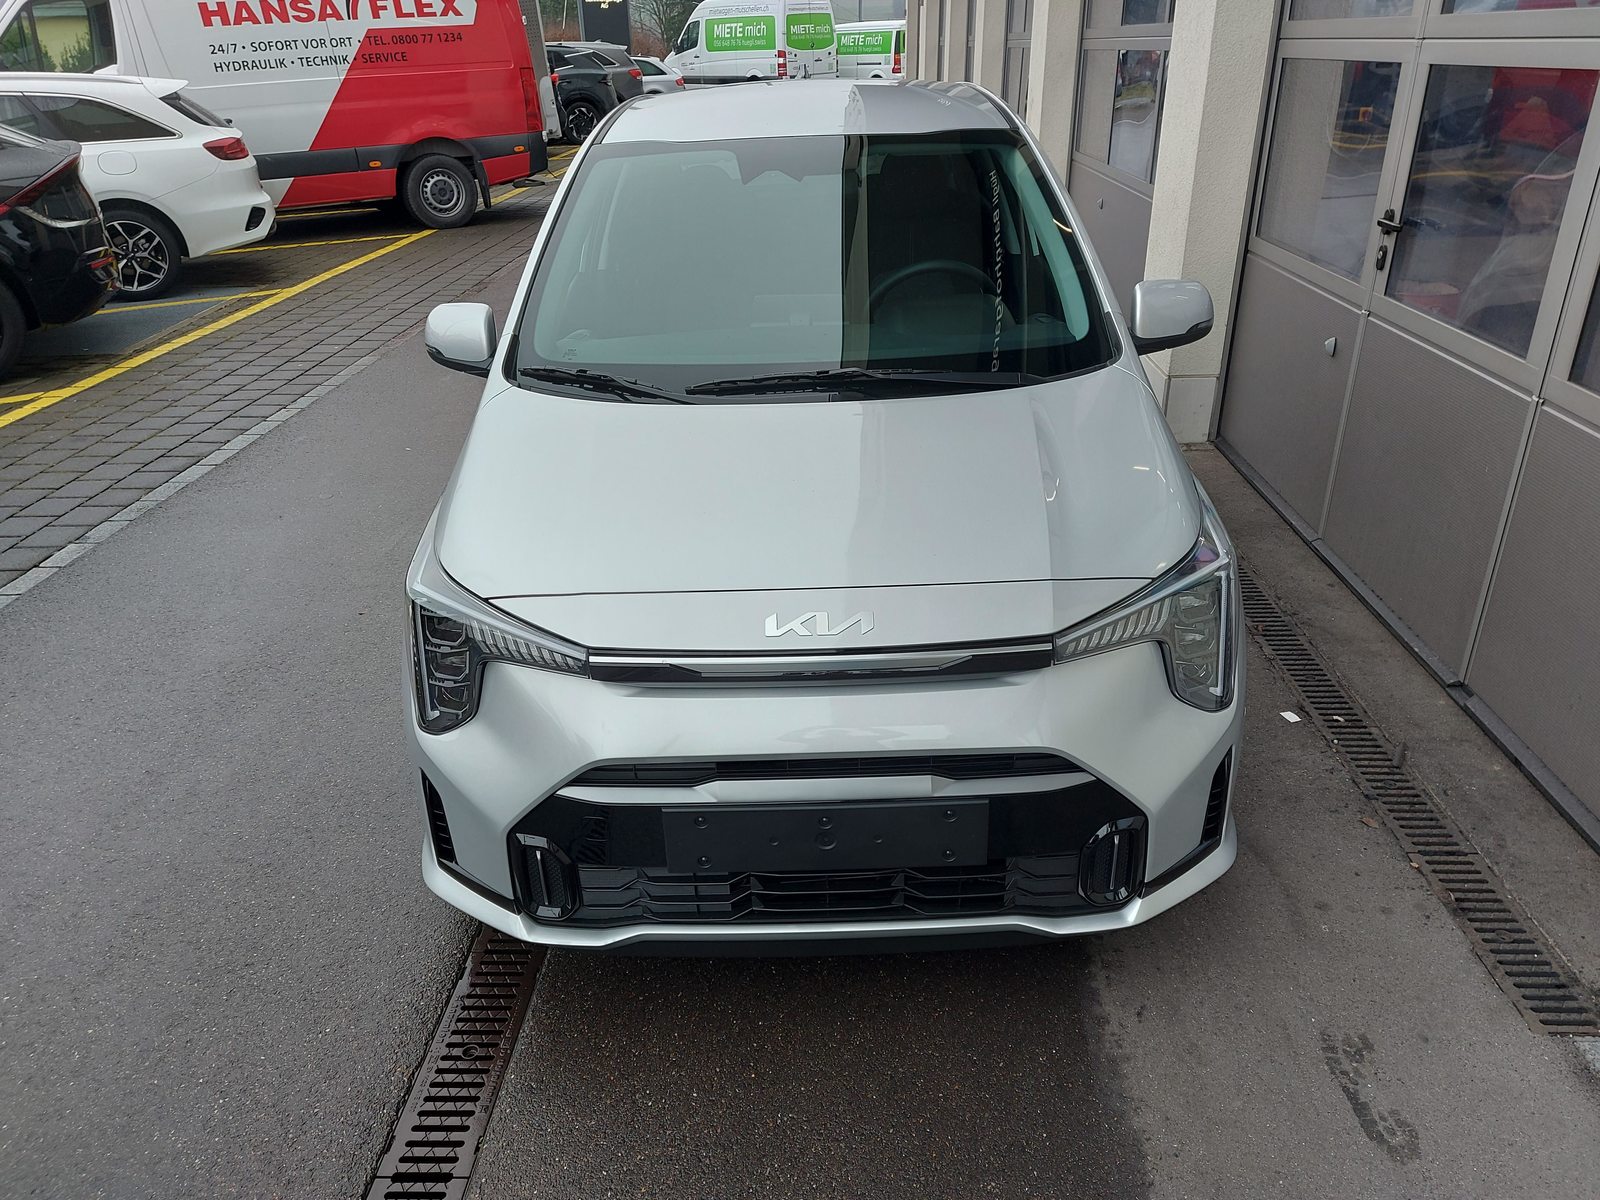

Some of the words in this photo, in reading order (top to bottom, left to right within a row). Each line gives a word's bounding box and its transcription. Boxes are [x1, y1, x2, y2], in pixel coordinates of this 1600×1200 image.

[197, 0, 344, 27] HANSA
[369, 0, 464, 20] FLEX
[713, 22, 743, 38] MIETE
[744, 21, 767, 37] mich
[790, 24, 815, 34] MIETE
[815, 24, 831, 33] mich
[841, 35, 865, 46] MIETE
[865, 34, 883, 46] mich
[208, 43, 238, 55] 24/7
[250, 39, 299, 53] SOFORT
[300, 38, 328, 49] VOR
[329, 36, 353, 48] ORT
[366, 35, 390, 46] TEL.
[391, 34, 419, 45] 0800
[420, 33, 434, 44] 77
[437, 32, 463, 43] 1234
[213, 58, 288, 73] HYDRAULIK
[297, 54, 351, 67] TECHNIK
[361, 51, 409, 64] SERVICE
[764, 611, 875, 637] KIA
